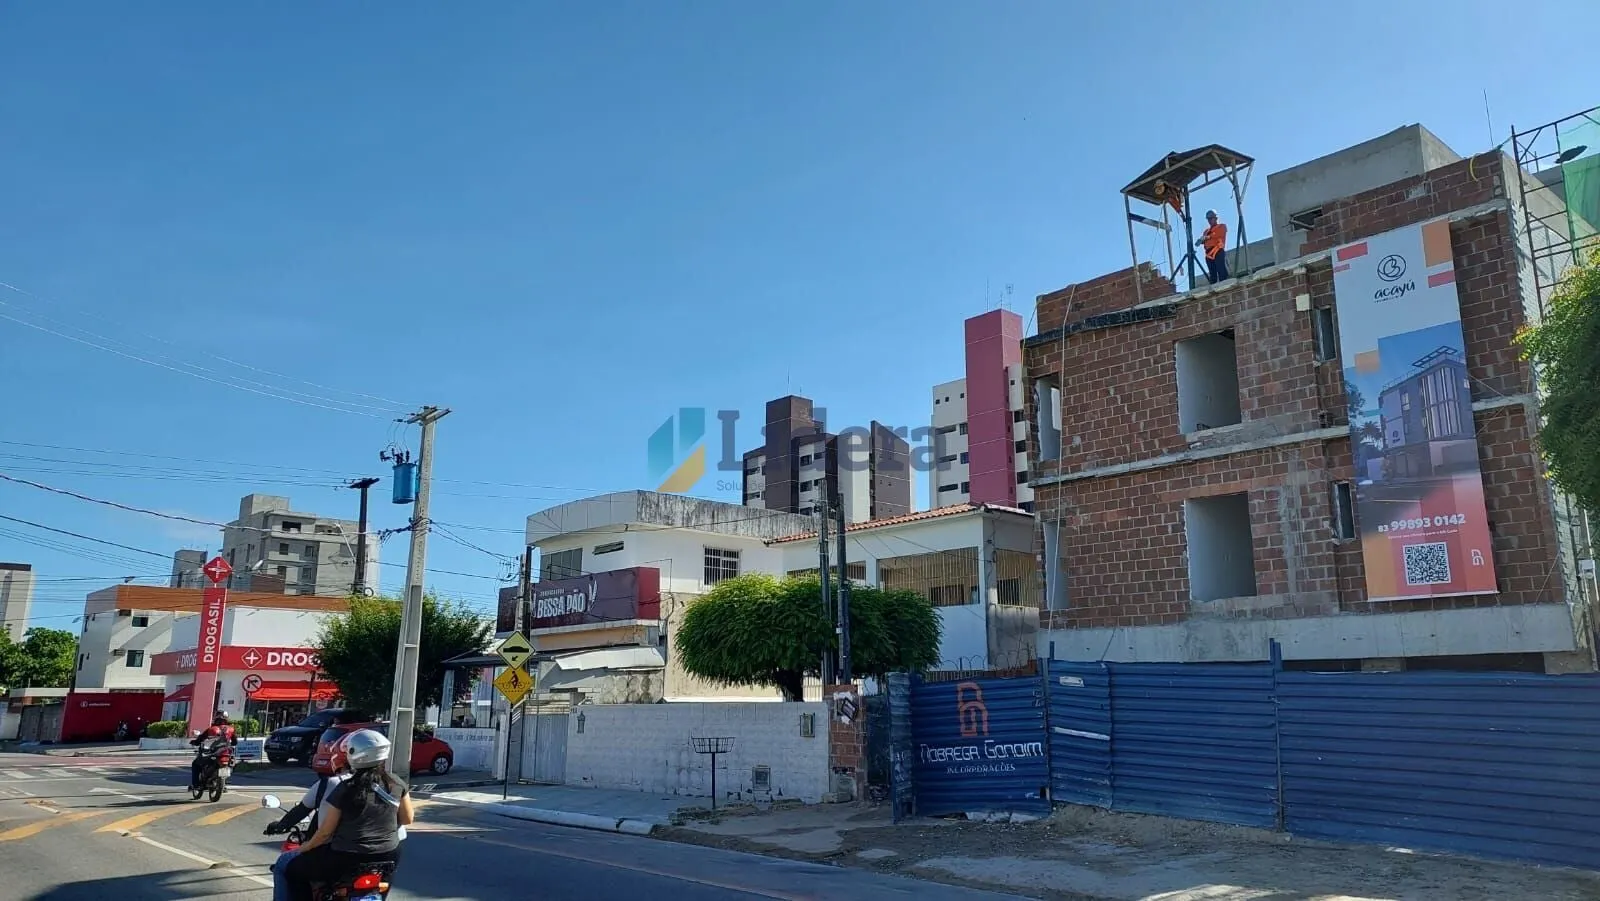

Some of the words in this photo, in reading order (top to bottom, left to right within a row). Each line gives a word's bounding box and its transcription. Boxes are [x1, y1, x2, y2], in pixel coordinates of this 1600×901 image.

[1391, 517, 1431, 531] 99893
[1434, 513, 1466, 527] 0142
[536, 595, 565, 619] BESSA
[566, 588, 586, 614] PÃO
[203, 598, 221, 663] DROGASIL
